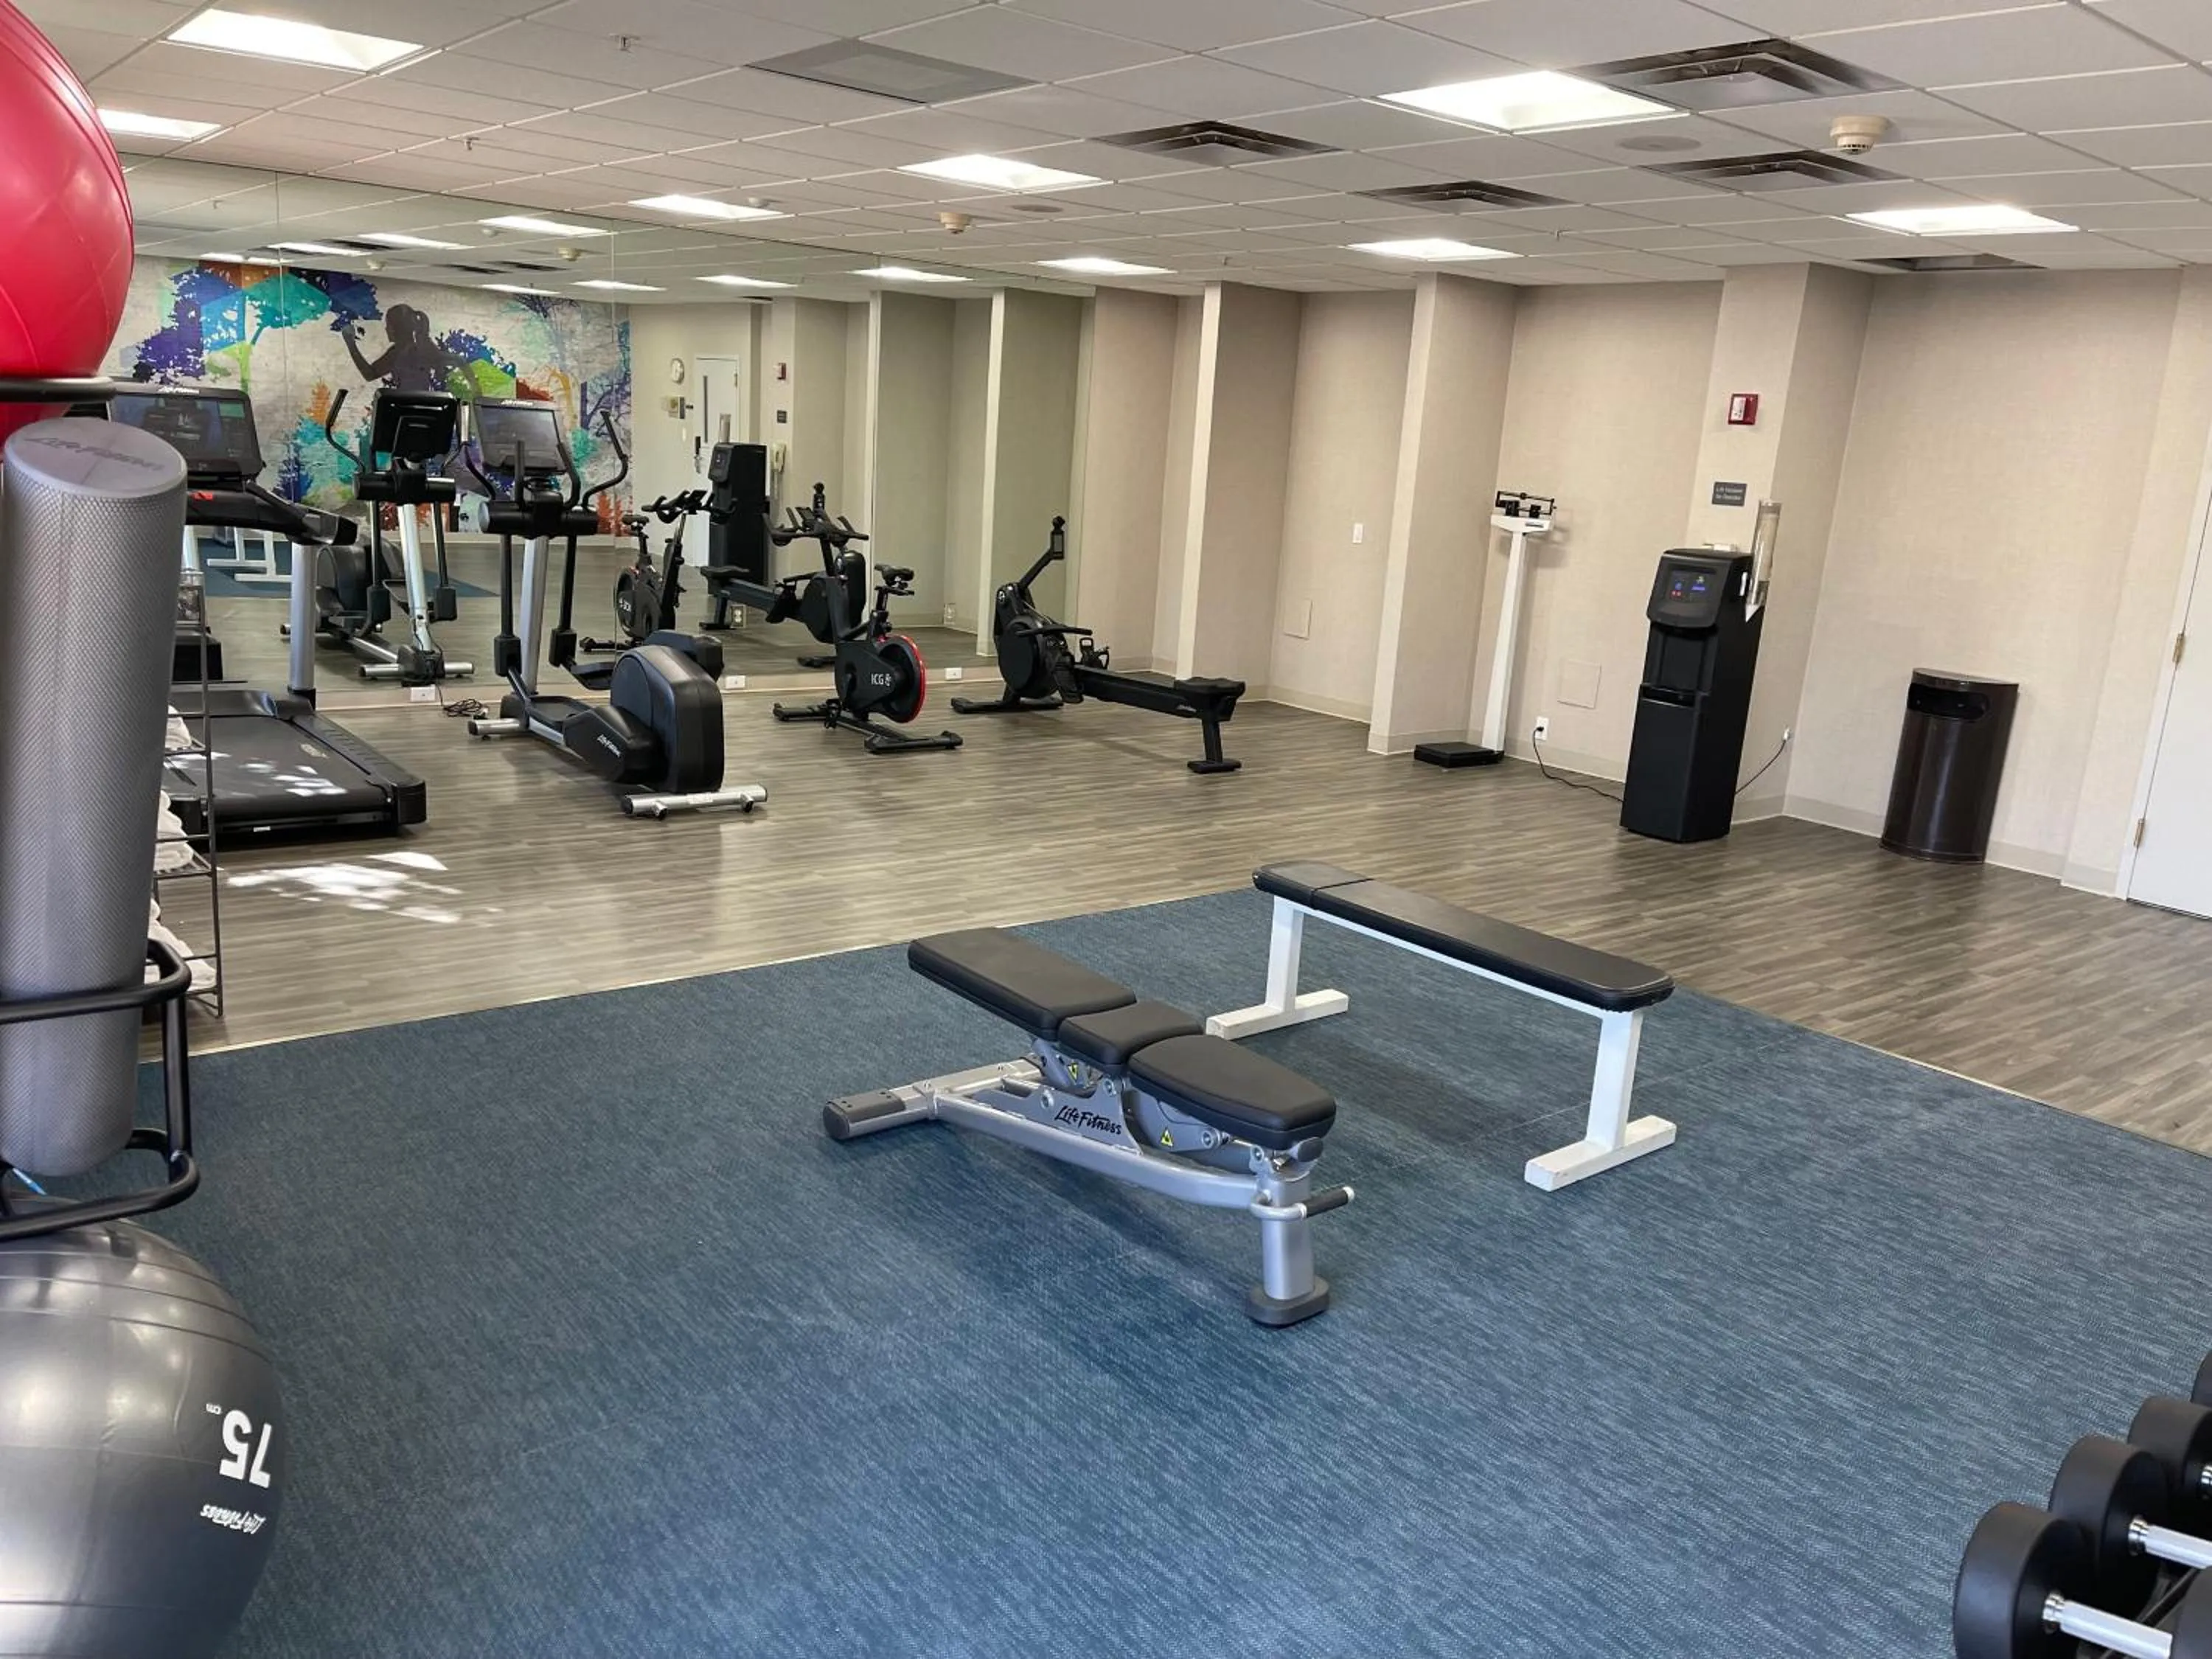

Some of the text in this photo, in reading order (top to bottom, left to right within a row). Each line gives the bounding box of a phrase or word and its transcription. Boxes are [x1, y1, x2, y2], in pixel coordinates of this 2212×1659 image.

[1054, 1105, 1121, 1135] Life Fitness
[206, 1403, 272, 1488] 75 cm
